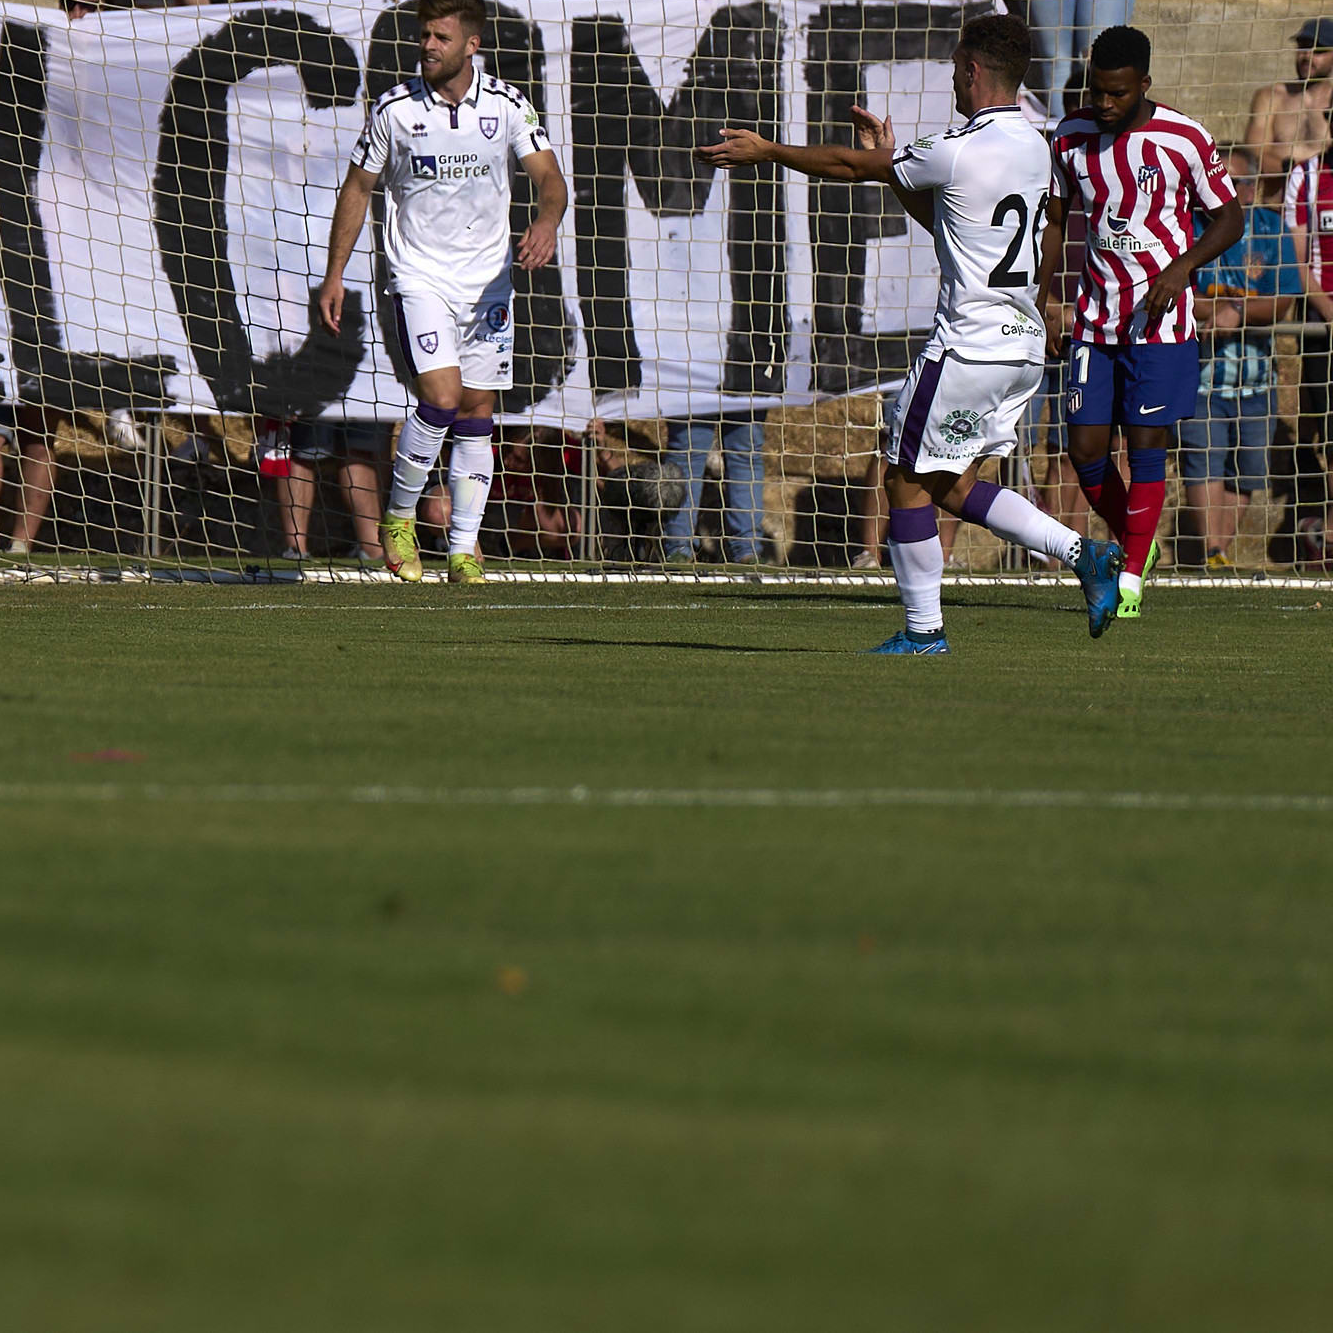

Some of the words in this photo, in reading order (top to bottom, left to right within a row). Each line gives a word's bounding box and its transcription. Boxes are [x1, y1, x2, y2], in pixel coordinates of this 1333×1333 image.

[438, 153, 478, 166] Grupo
[439, 163, 490, 180] Herce
[1093, 235, 1161, 251] haleFin.com
